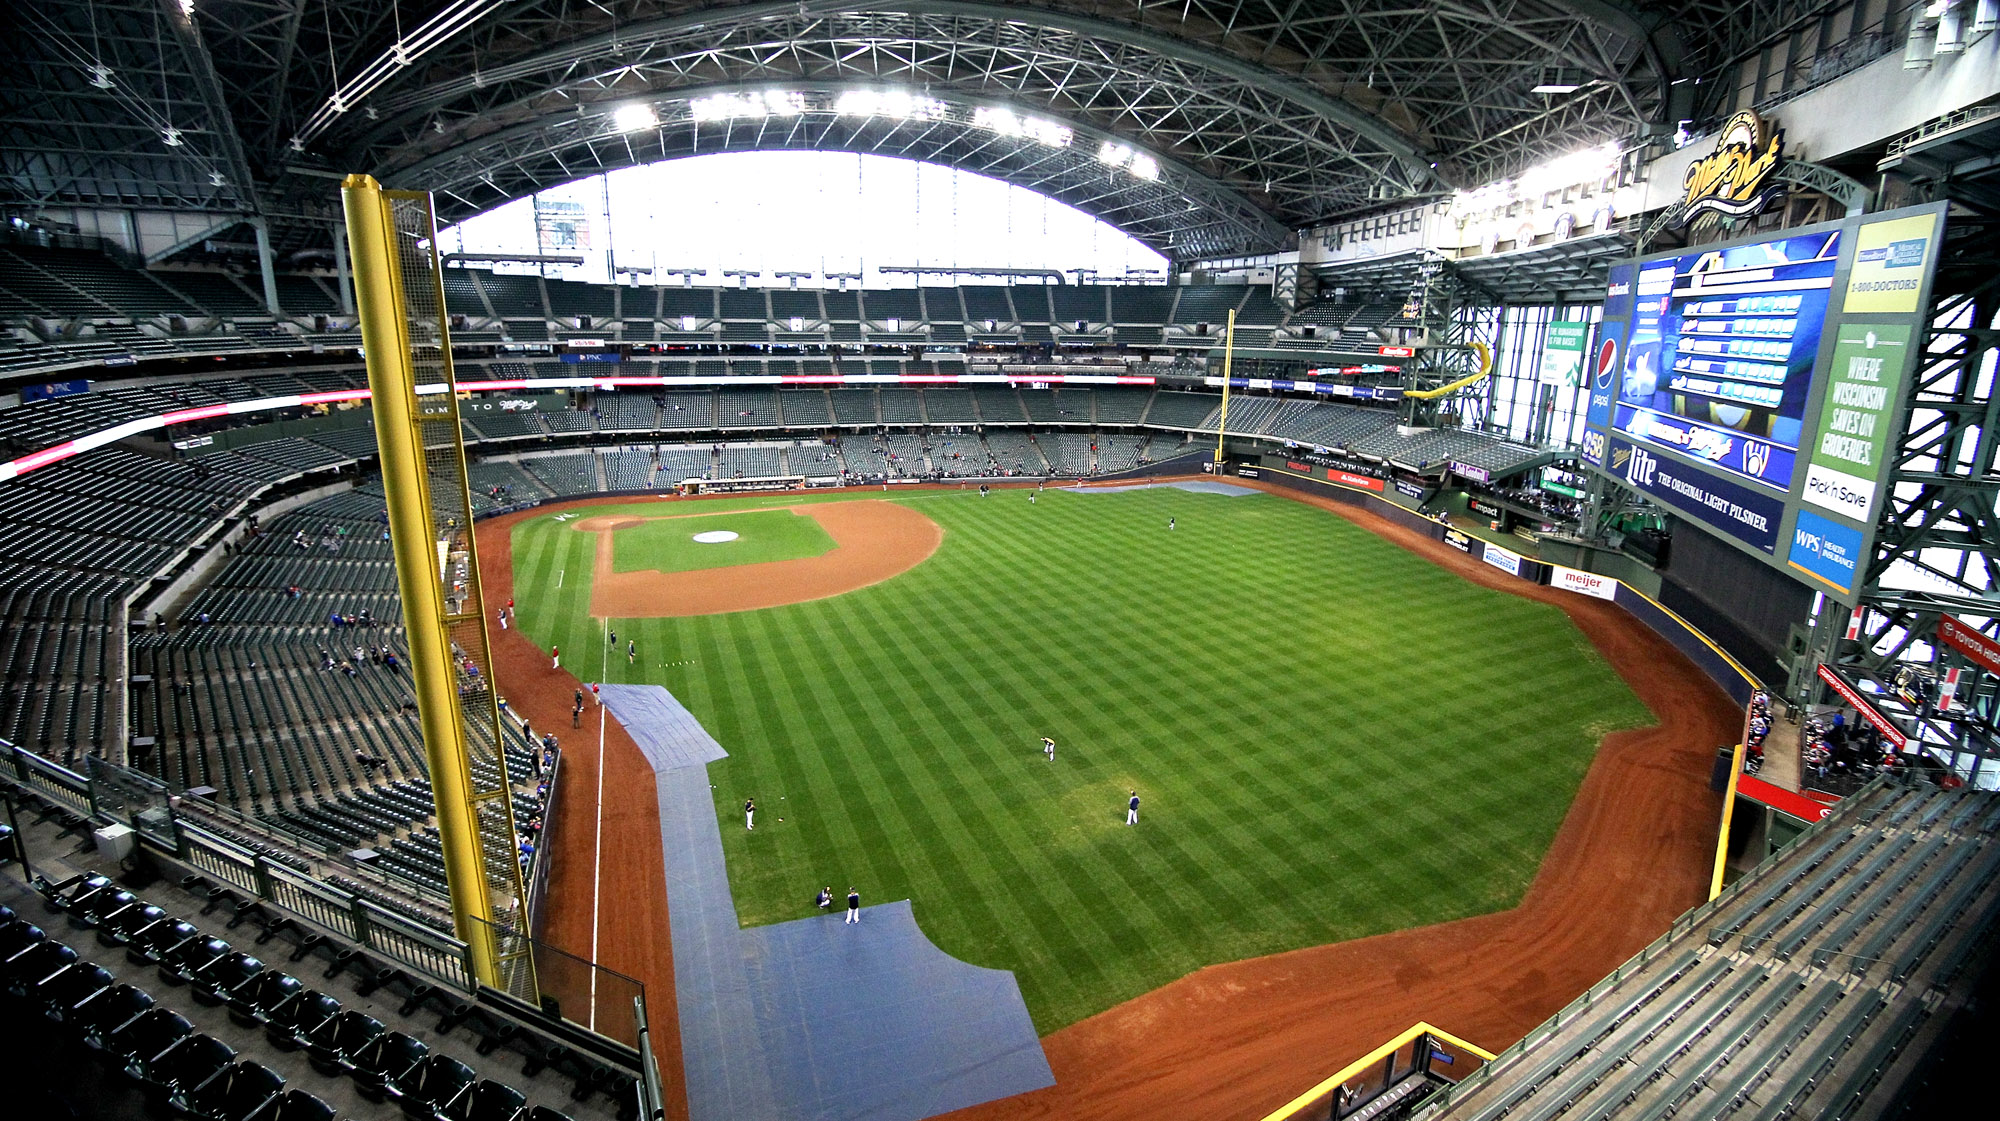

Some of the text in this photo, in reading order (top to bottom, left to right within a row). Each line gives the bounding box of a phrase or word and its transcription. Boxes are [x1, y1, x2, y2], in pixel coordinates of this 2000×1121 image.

[1683, 133, 1780, 206] Miller Park
[1851, 278, 1918, 293] 1-800-DOCTORS
[585, 353, 602, 361] PNC
[1847, 356, 1884, 383] WHERE
[54, 382, 71, 393] PNC
[1593, 393, 1610, 408] pepsi
[1832, 382, 1888, 410] WISCONSIN
[1830, 408, 1877, 438] SAVES ON
[1590, 433, 1605, 459] 58
[1821, 433, 1873, 466] GROCERIES.
[1625, 444, 1657, 487] Lite
[1657, 471, 1768, 533] THE ORIGINAL LIGHT PILSNER.
[1809, 477, 1829, 495] Pick
[1840, 487, 1866, 508] Save
[1475, 502, 1498, 518] impact
[1795, 528, 1846, 556] WPS HEALTH
[1822, 549, 1855, 570] INSURANCE
[1565, 572, 1602, 588] meijer
[1955, 630, 1983, 655] TOYOTA
